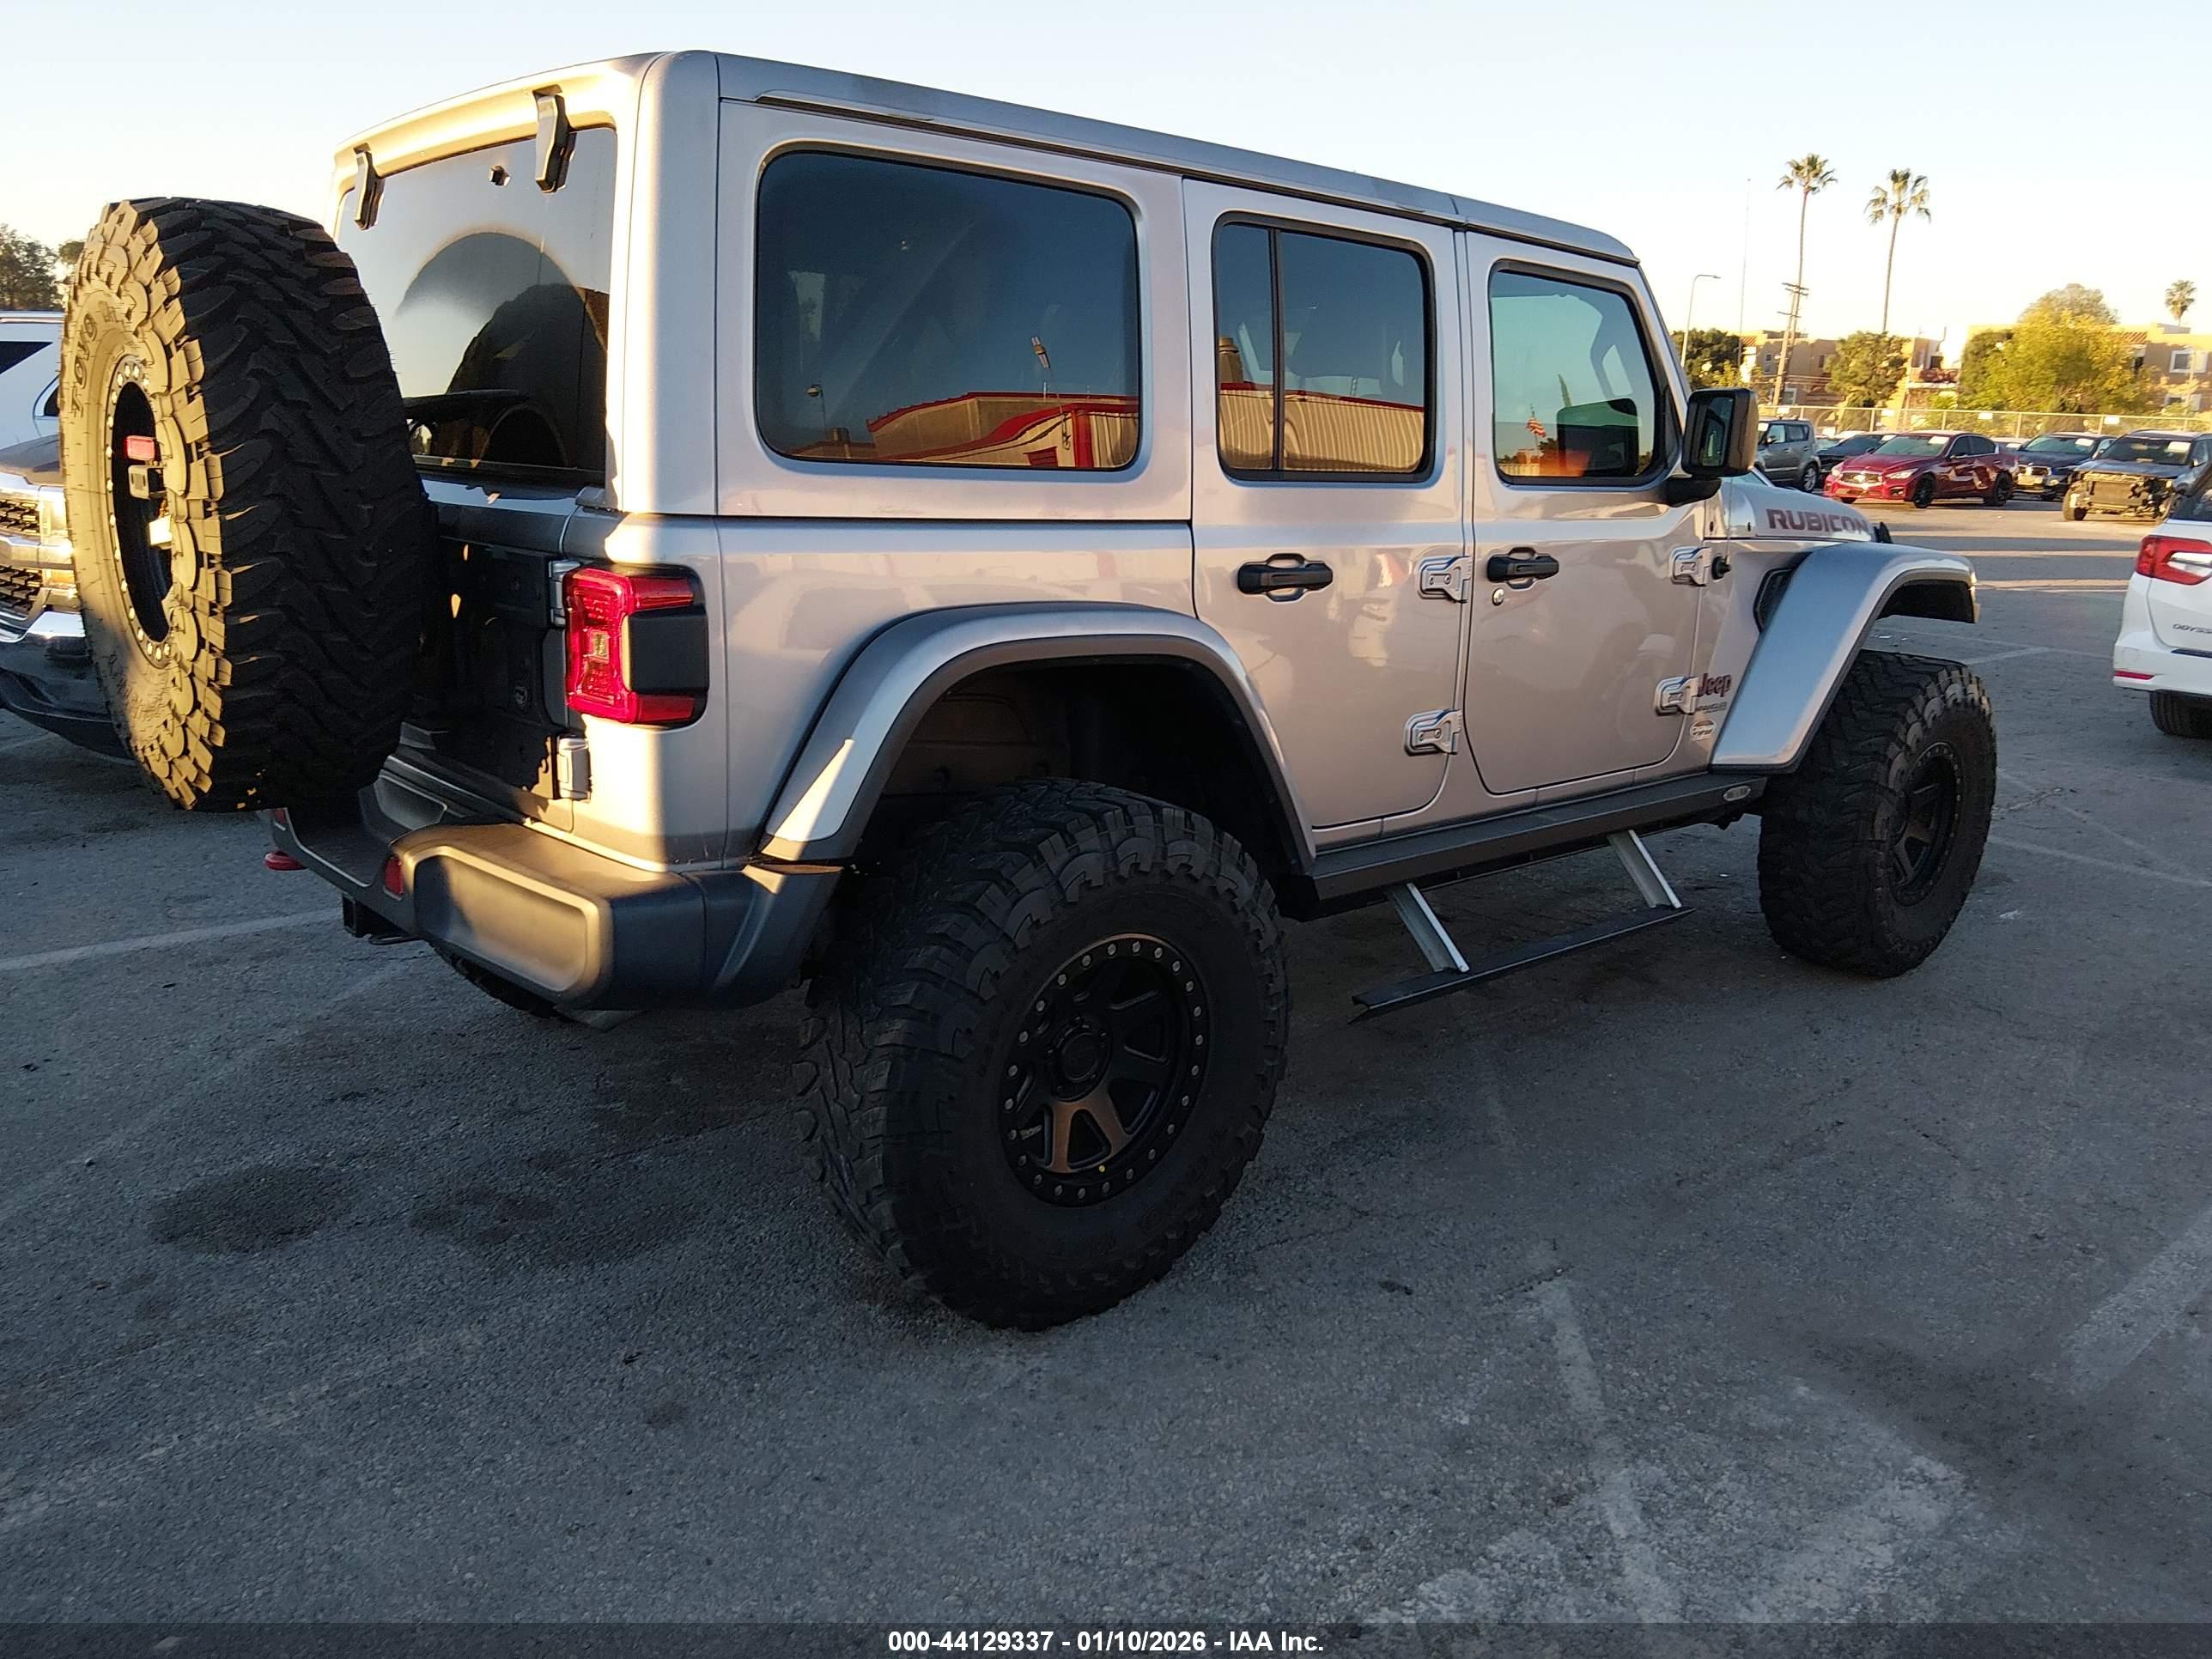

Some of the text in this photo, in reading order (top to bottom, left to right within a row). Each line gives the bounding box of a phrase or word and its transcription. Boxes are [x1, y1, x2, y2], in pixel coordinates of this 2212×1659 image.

[70, 313, 99, 419] TOYO
[1765, 508, 1870, 533] RUBICON
[1697, 672, 1732, 698] Jeep
